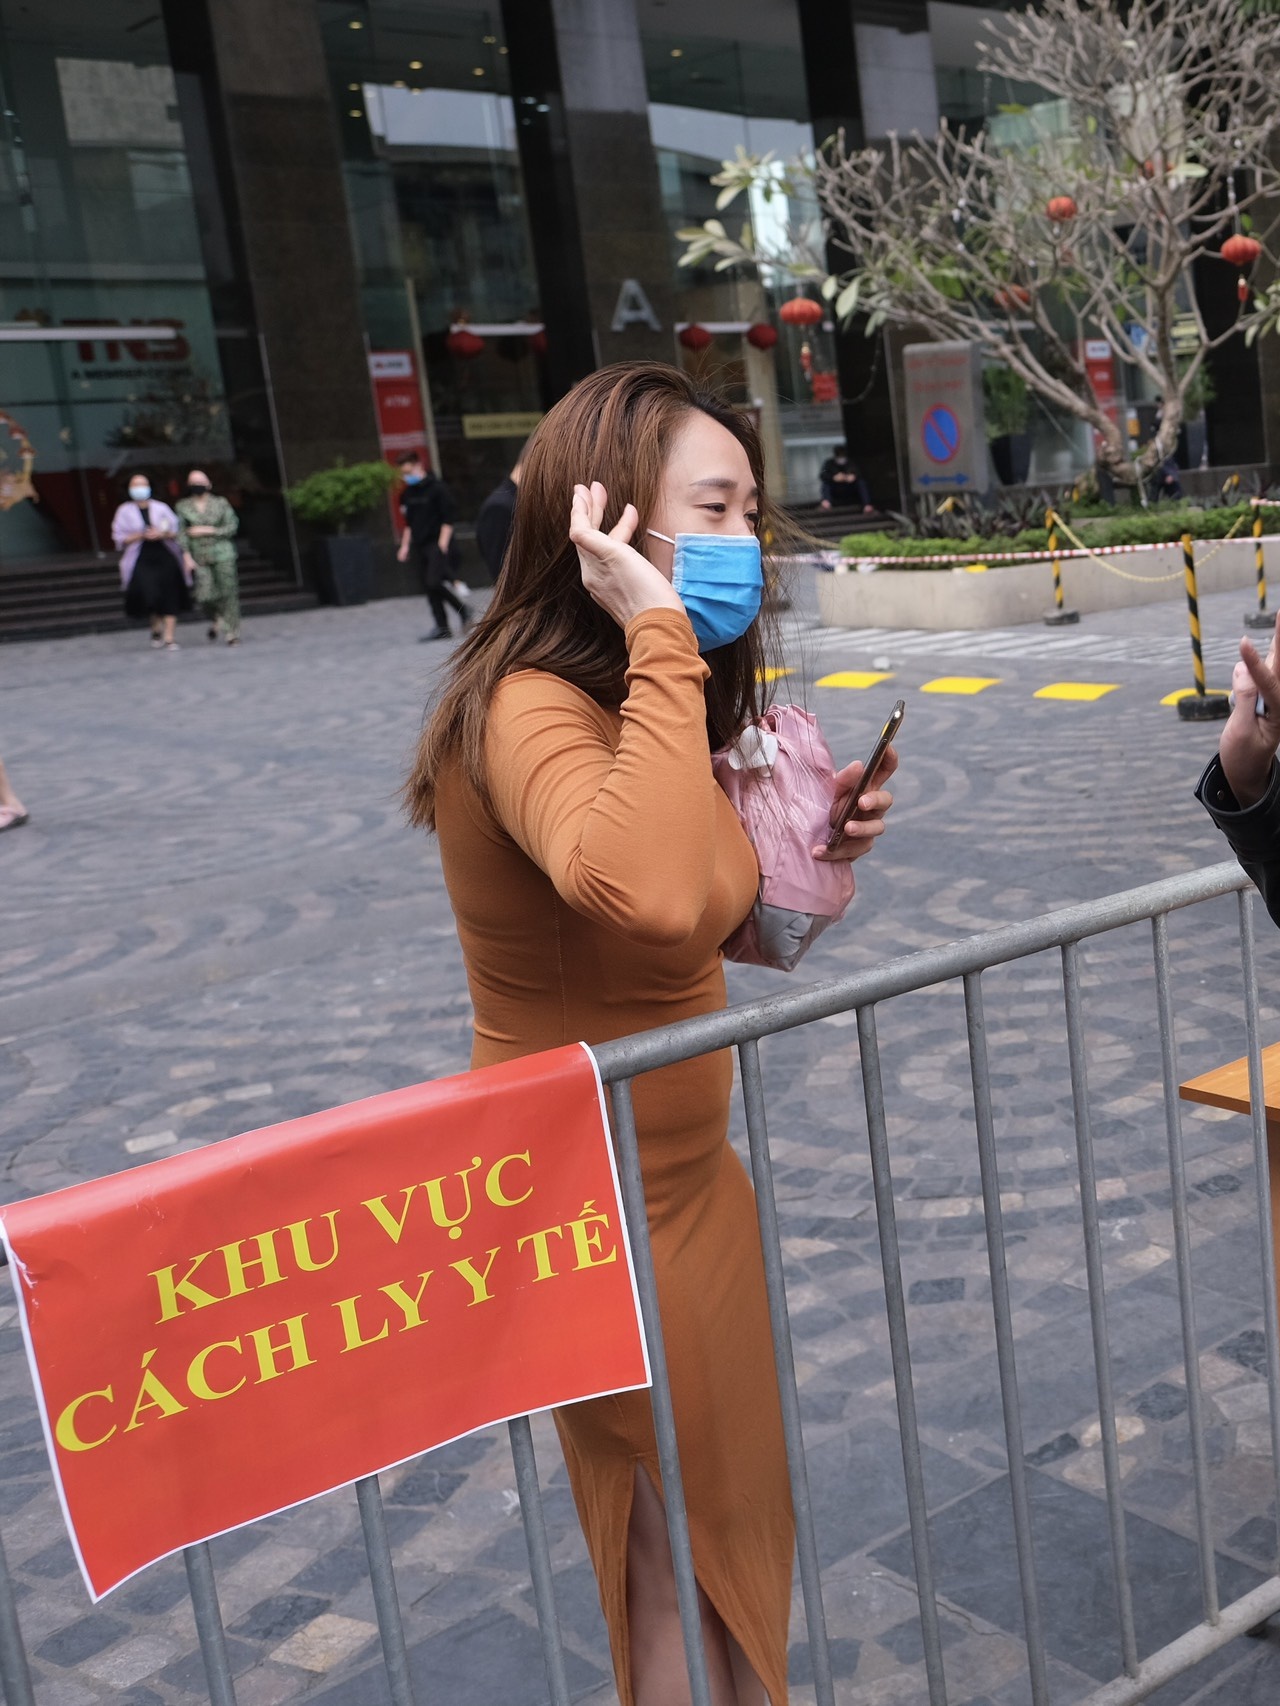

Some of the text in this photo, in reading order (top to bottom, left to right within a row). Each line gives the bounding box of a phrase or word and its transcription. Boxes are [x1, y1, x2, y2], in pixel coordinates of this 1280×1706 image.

[611, 278, 661, 332] A
[149, 1149, 535, 1324] KHU VỰC
[55, 1199, 619, 1453] CÁCH LY Y TẾ
